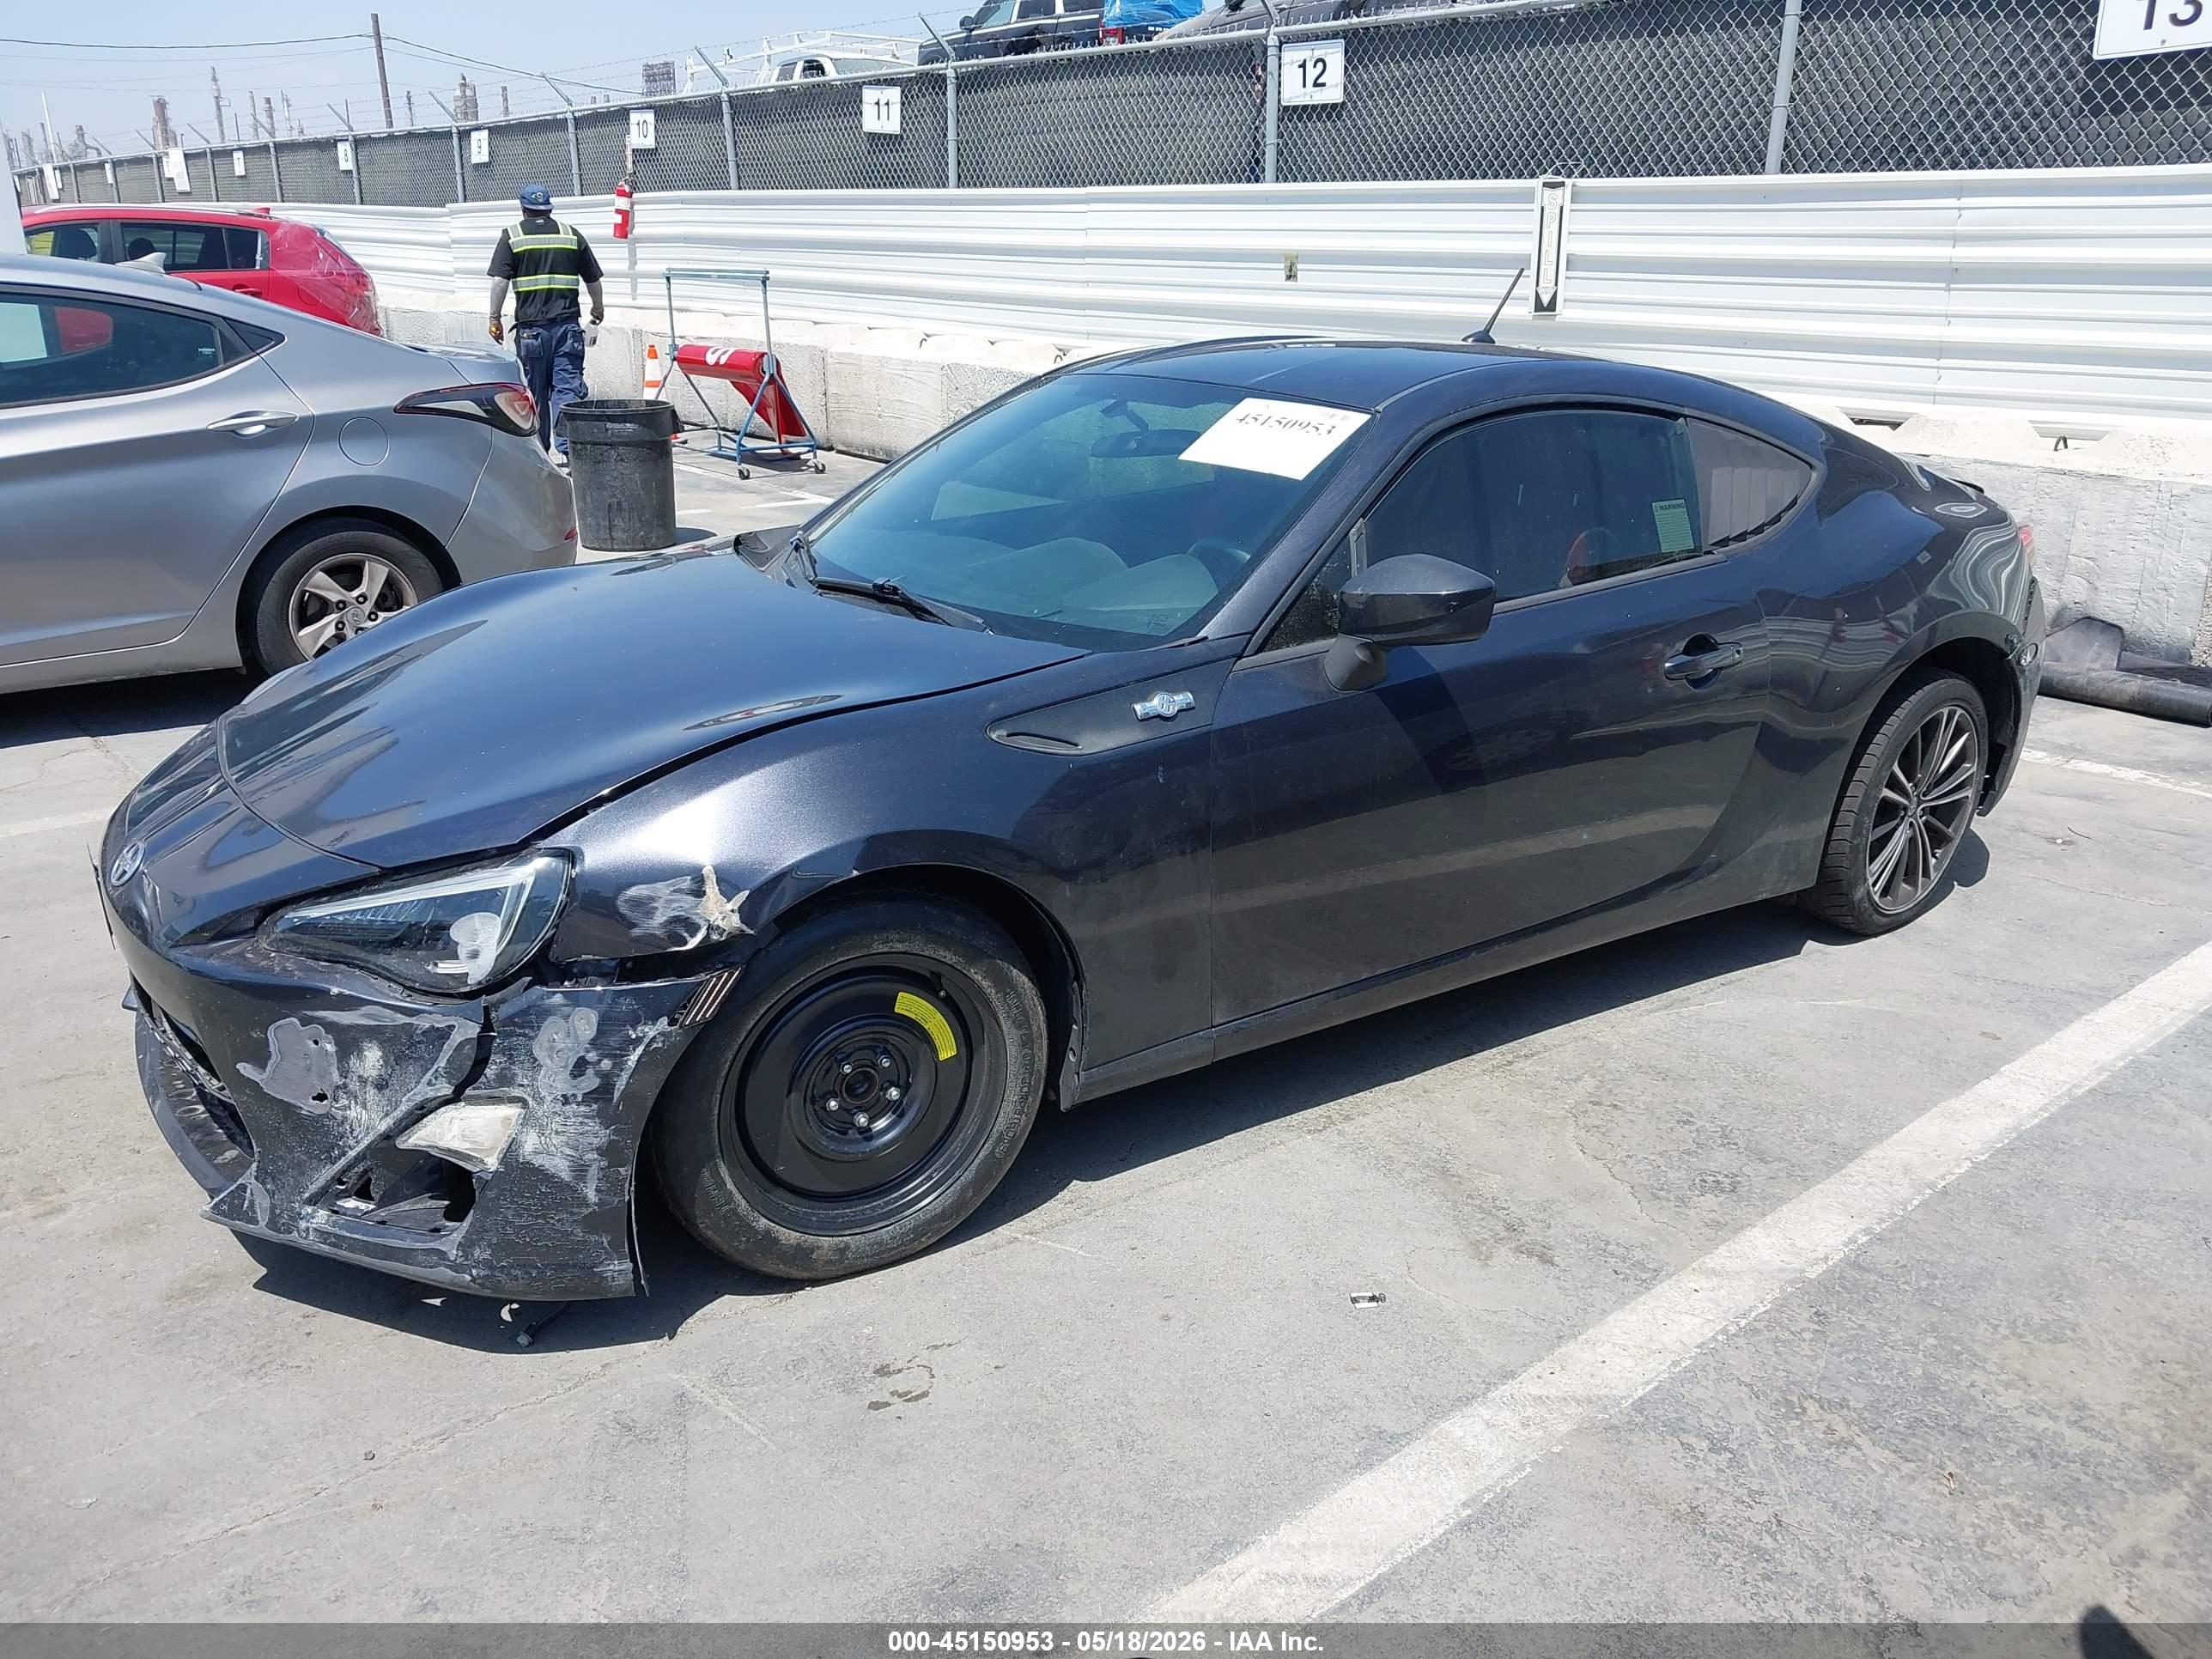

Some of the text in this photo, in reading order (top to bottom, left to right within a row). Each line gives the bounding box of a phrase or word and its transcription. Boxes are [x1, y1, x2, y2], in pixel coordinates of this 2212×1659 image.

[2136, 0, 2203, 31] 13
[1297, 57, 1328, 89] 12
[873, 97, 890, 121] 11
[635, 119, 648, 139] 10
[343, 149, 349, 163] 8
[477, 138, 482, 155] 9
[1542, 192, 1558, 284] SPILL
[1236, 412, 1337, 436] 45150953
[1659, 502, 1685, 512] WARNING
